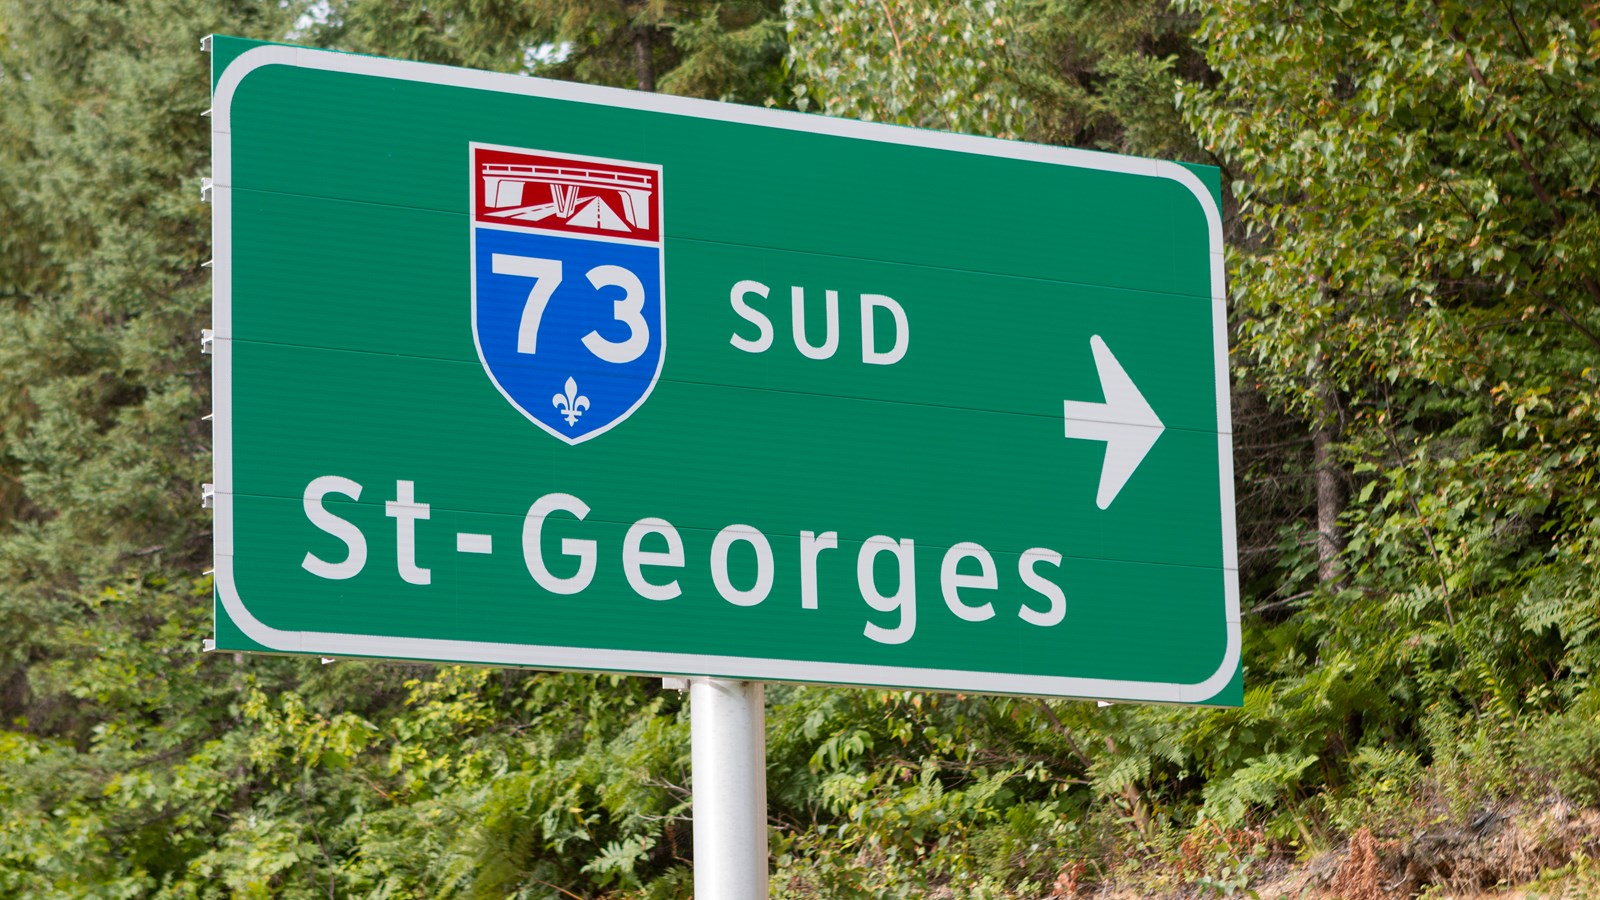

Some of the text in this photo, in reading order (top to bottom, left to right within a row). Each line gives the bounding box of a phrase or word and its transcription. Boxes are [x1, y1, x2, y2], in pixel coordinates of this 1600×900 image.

[491, 253, 651, 364] 73
[729, 279, 910, 366] SUD
[301, 475, 1067, 645] St-Georges
